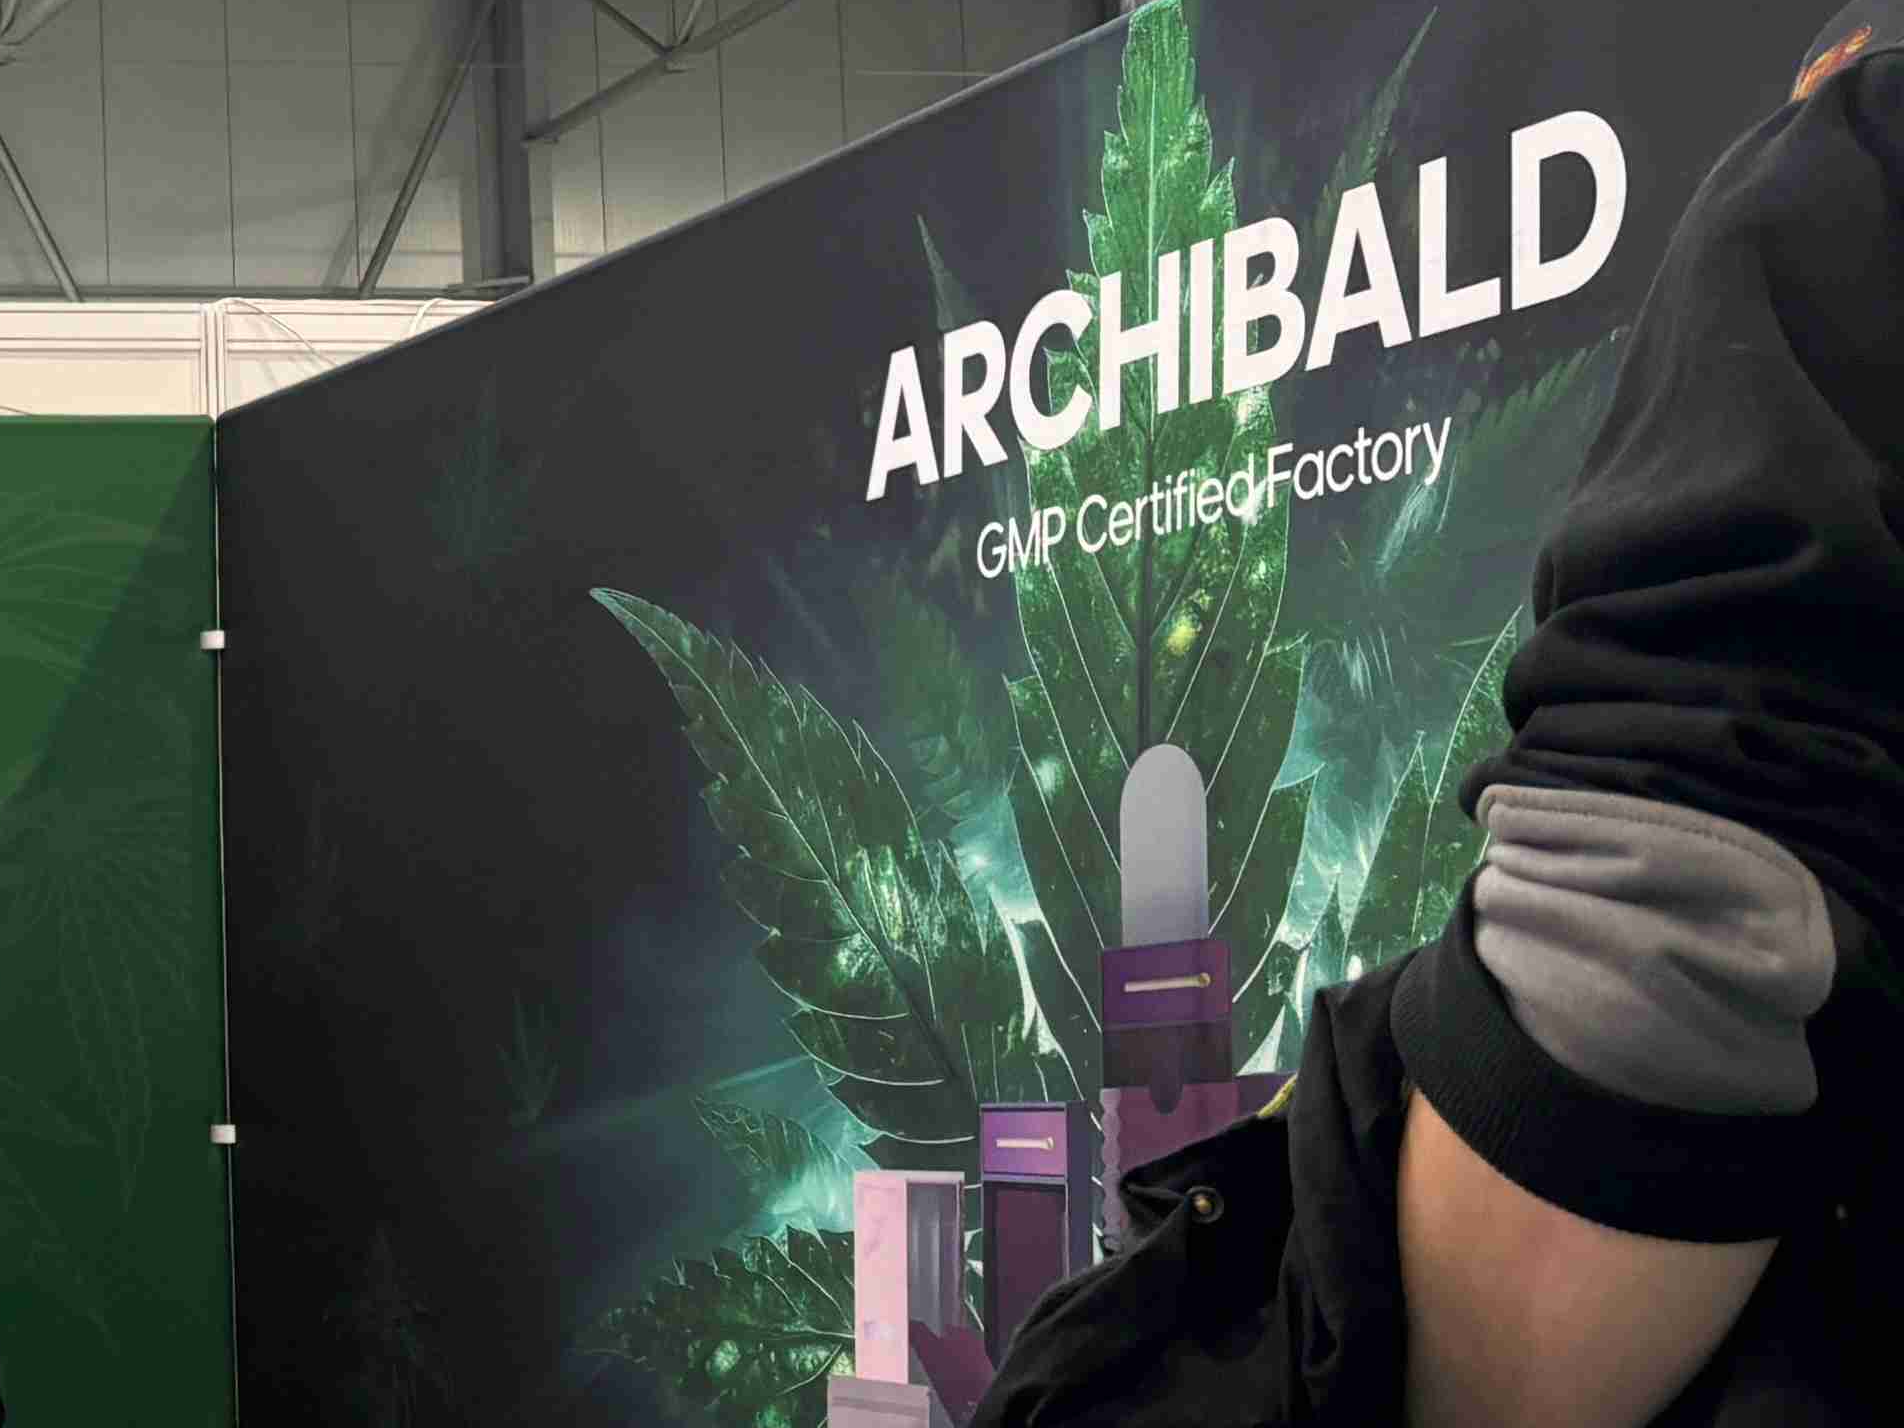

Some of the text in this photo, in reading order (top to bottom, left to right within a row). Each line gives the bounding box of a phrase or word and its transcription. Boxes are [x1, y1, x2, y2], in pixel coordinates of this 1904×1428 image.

[865, 109, 1629, 502] ARCHIBALD
[975, 416, 1453, 579] GMP Certified Factory
